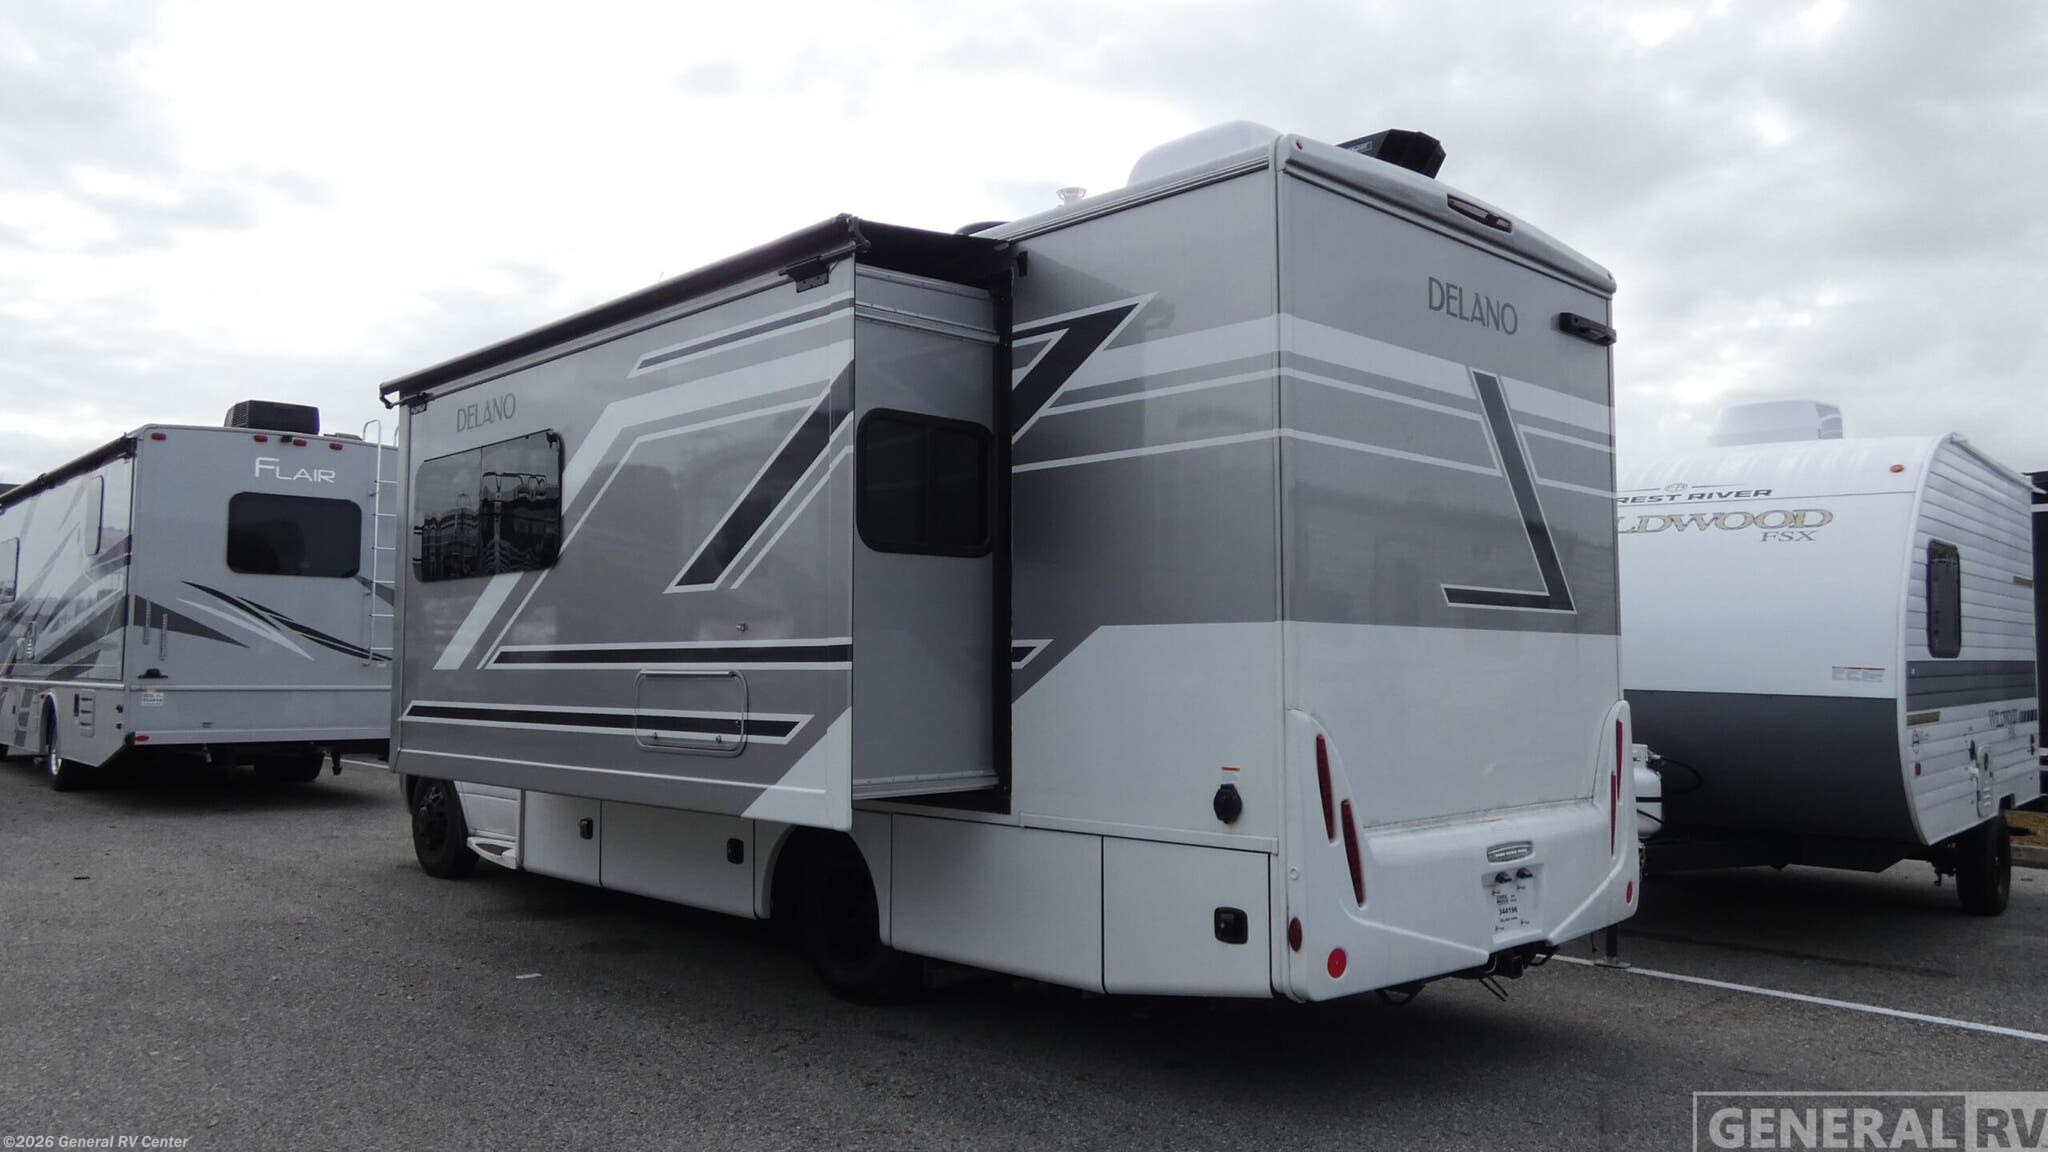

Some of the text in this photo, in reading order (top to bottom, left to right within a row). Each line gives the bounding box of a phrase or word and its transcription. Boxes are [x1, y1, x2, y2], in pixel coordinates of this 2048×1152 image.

[1428, 276, 1518, 335] DELANO
[457, 392, 516, 432] DELANO
[255, 457, 336, 483] FLAIR
[1688, 489, 1773, 501] RIVER
[1761, 531, 1817, 542] FSX
